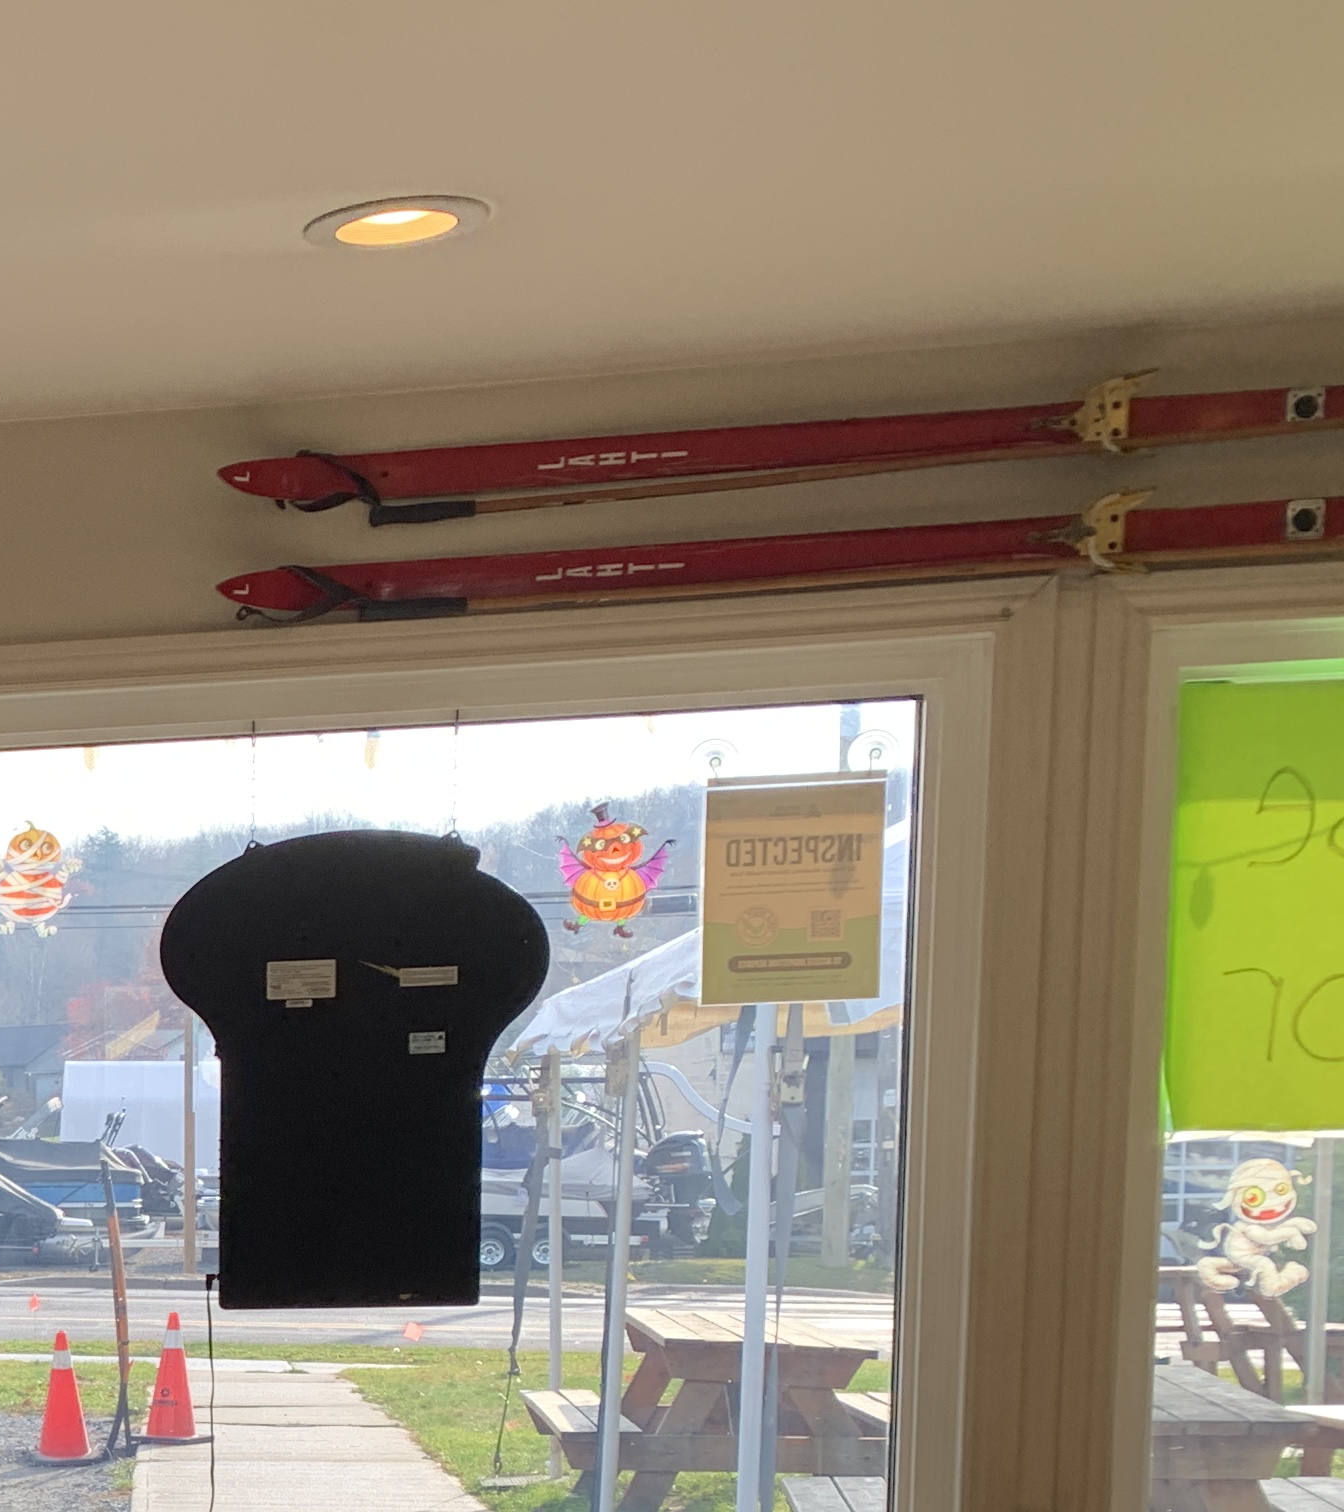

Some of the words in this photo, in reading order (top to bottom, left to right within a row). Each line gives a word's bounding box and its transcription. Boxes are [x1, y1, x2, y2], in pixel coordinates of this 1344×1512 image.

[537, 451, 688, 470] LAHTI
[232, 470, 250, 482] L
[535, 562, 685, 581] LAHTI
[232, 583, 249, 595] L
